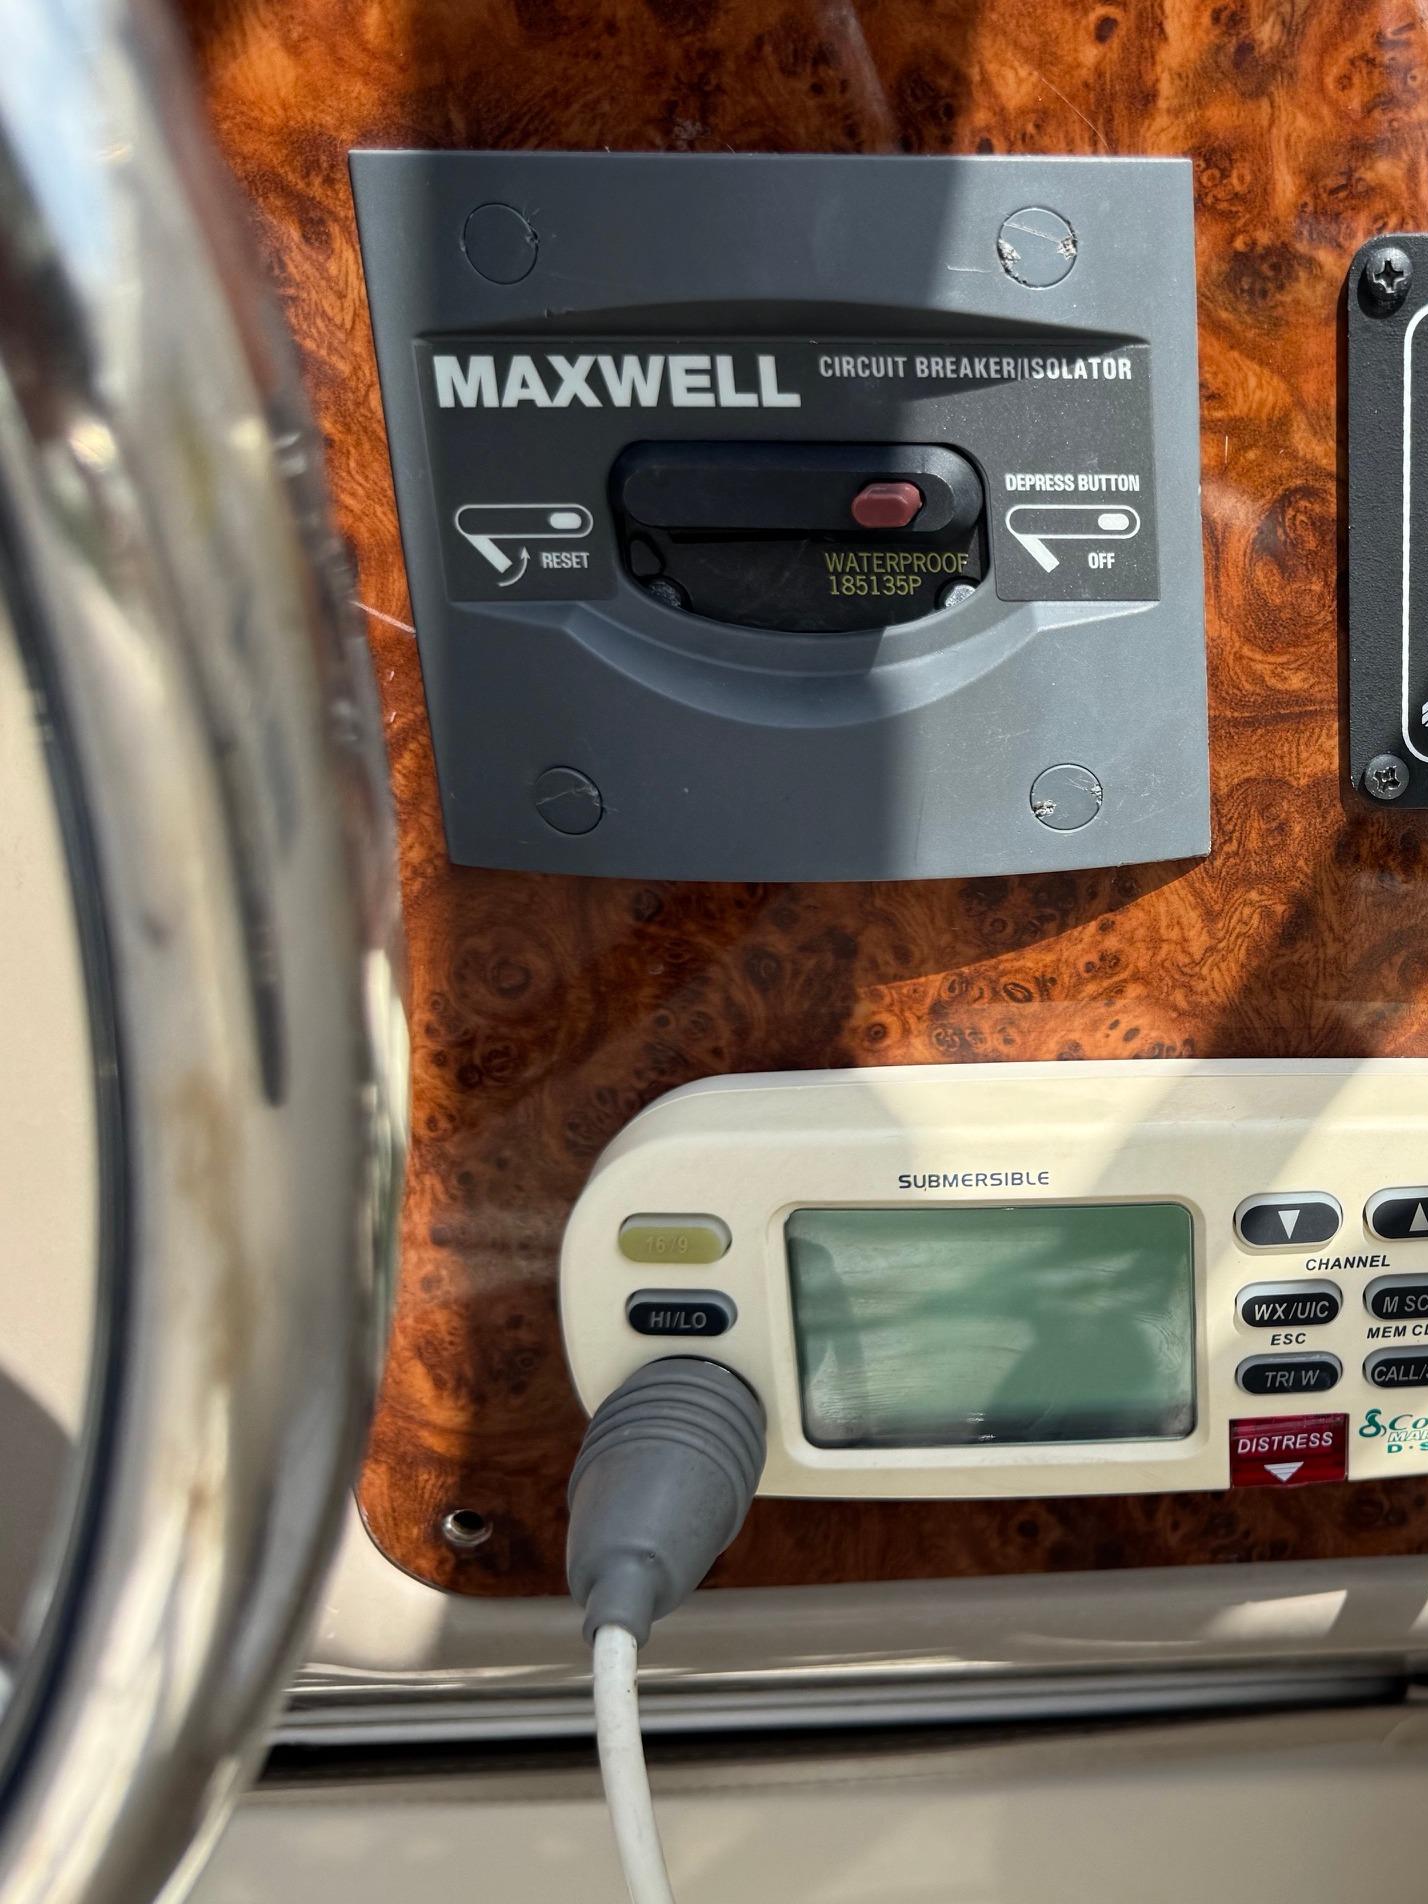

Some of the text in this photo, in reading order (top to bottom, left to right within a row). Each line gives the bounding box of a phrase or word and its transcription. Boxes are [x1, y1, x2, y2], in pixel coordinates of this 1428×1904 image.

[818, 356, 1132, 381] CIRCUIT BREAKER/ISOLATOR
[433, 354, 801, 408] MAXWELL
[1005, 473, 1140, 493] DEPRESS BUTTON
[541, 551, 590, 569] RESET
[825, 552, 970, 574] WATERPROOF
[1088, 553, 1116, 569] OFF
[830, 576, 922, 595] 185135P
[898, 1171, 1051, 1190] SUBMERSIBLE
[1305, 1255, 1391, 1271] CHANNEL
[649, 1310, 708, 1330] HI/LO
[1270, 1333, 1307, 1346] ESC
[1366, 1325, 1407, 1339] MEM
[1265, 1370, 1320, 1388] TRI W
[1237, 1432, 1333, 1454] DISTRESS
